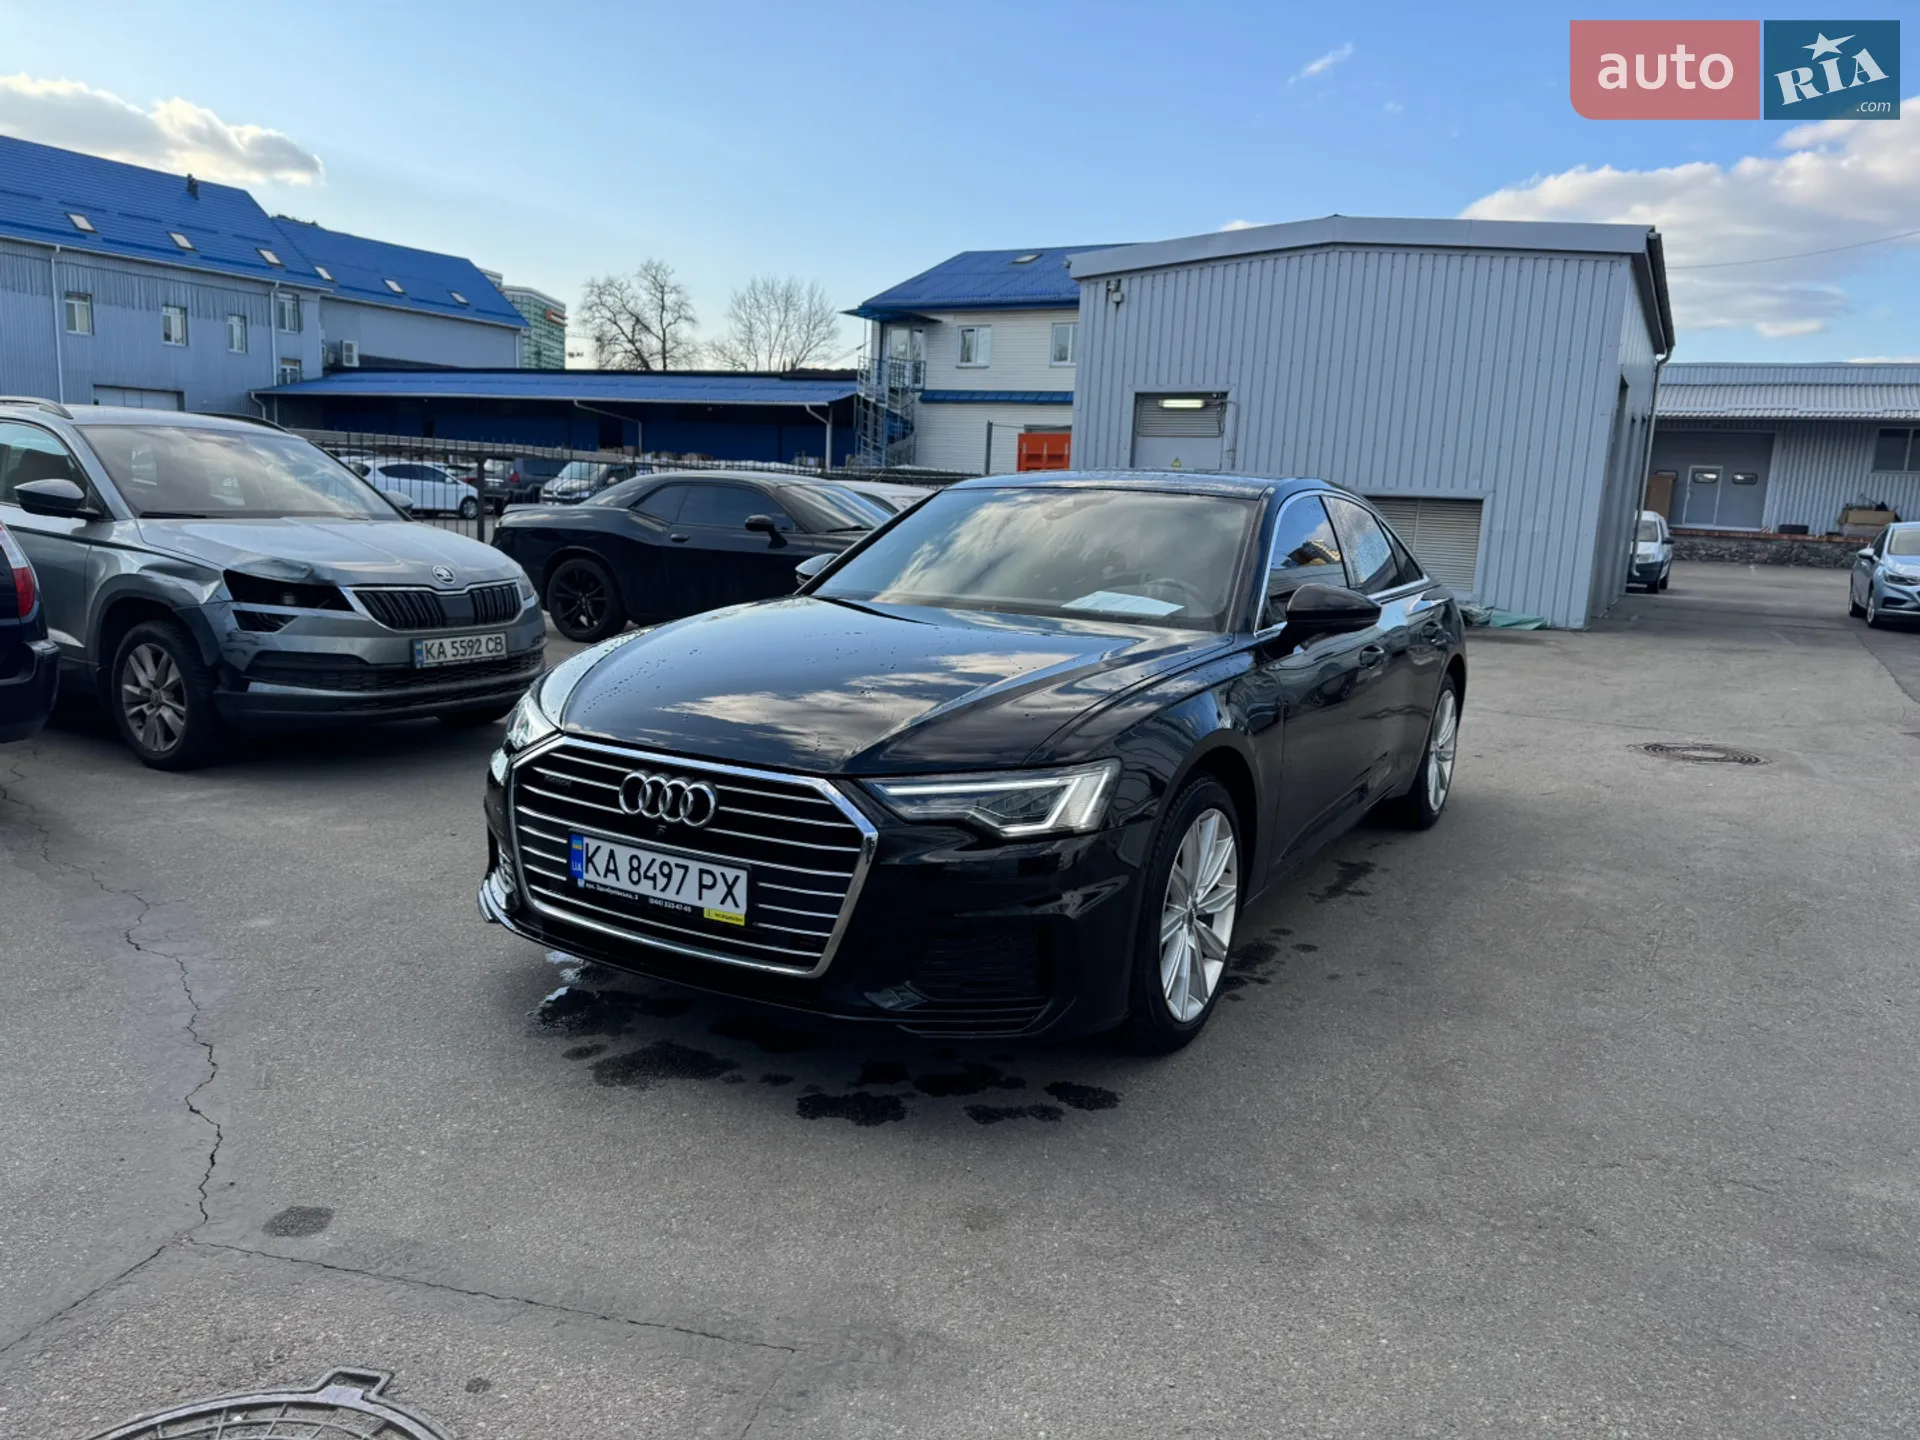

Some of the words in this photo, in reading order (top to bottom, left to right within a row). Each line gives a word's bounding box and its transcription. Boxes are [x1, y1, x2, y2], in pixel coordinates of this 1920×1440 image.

[425, 642, 447, 660] KA
[451, 639, 482, 657] 5592
[486, 637, 504, 653] CB
[571, 861, 582, 873] UA
[585, 842, 620, 882] KA
[628, 854, 689, 896] 8497
[699, 868, 741, 908] PX
